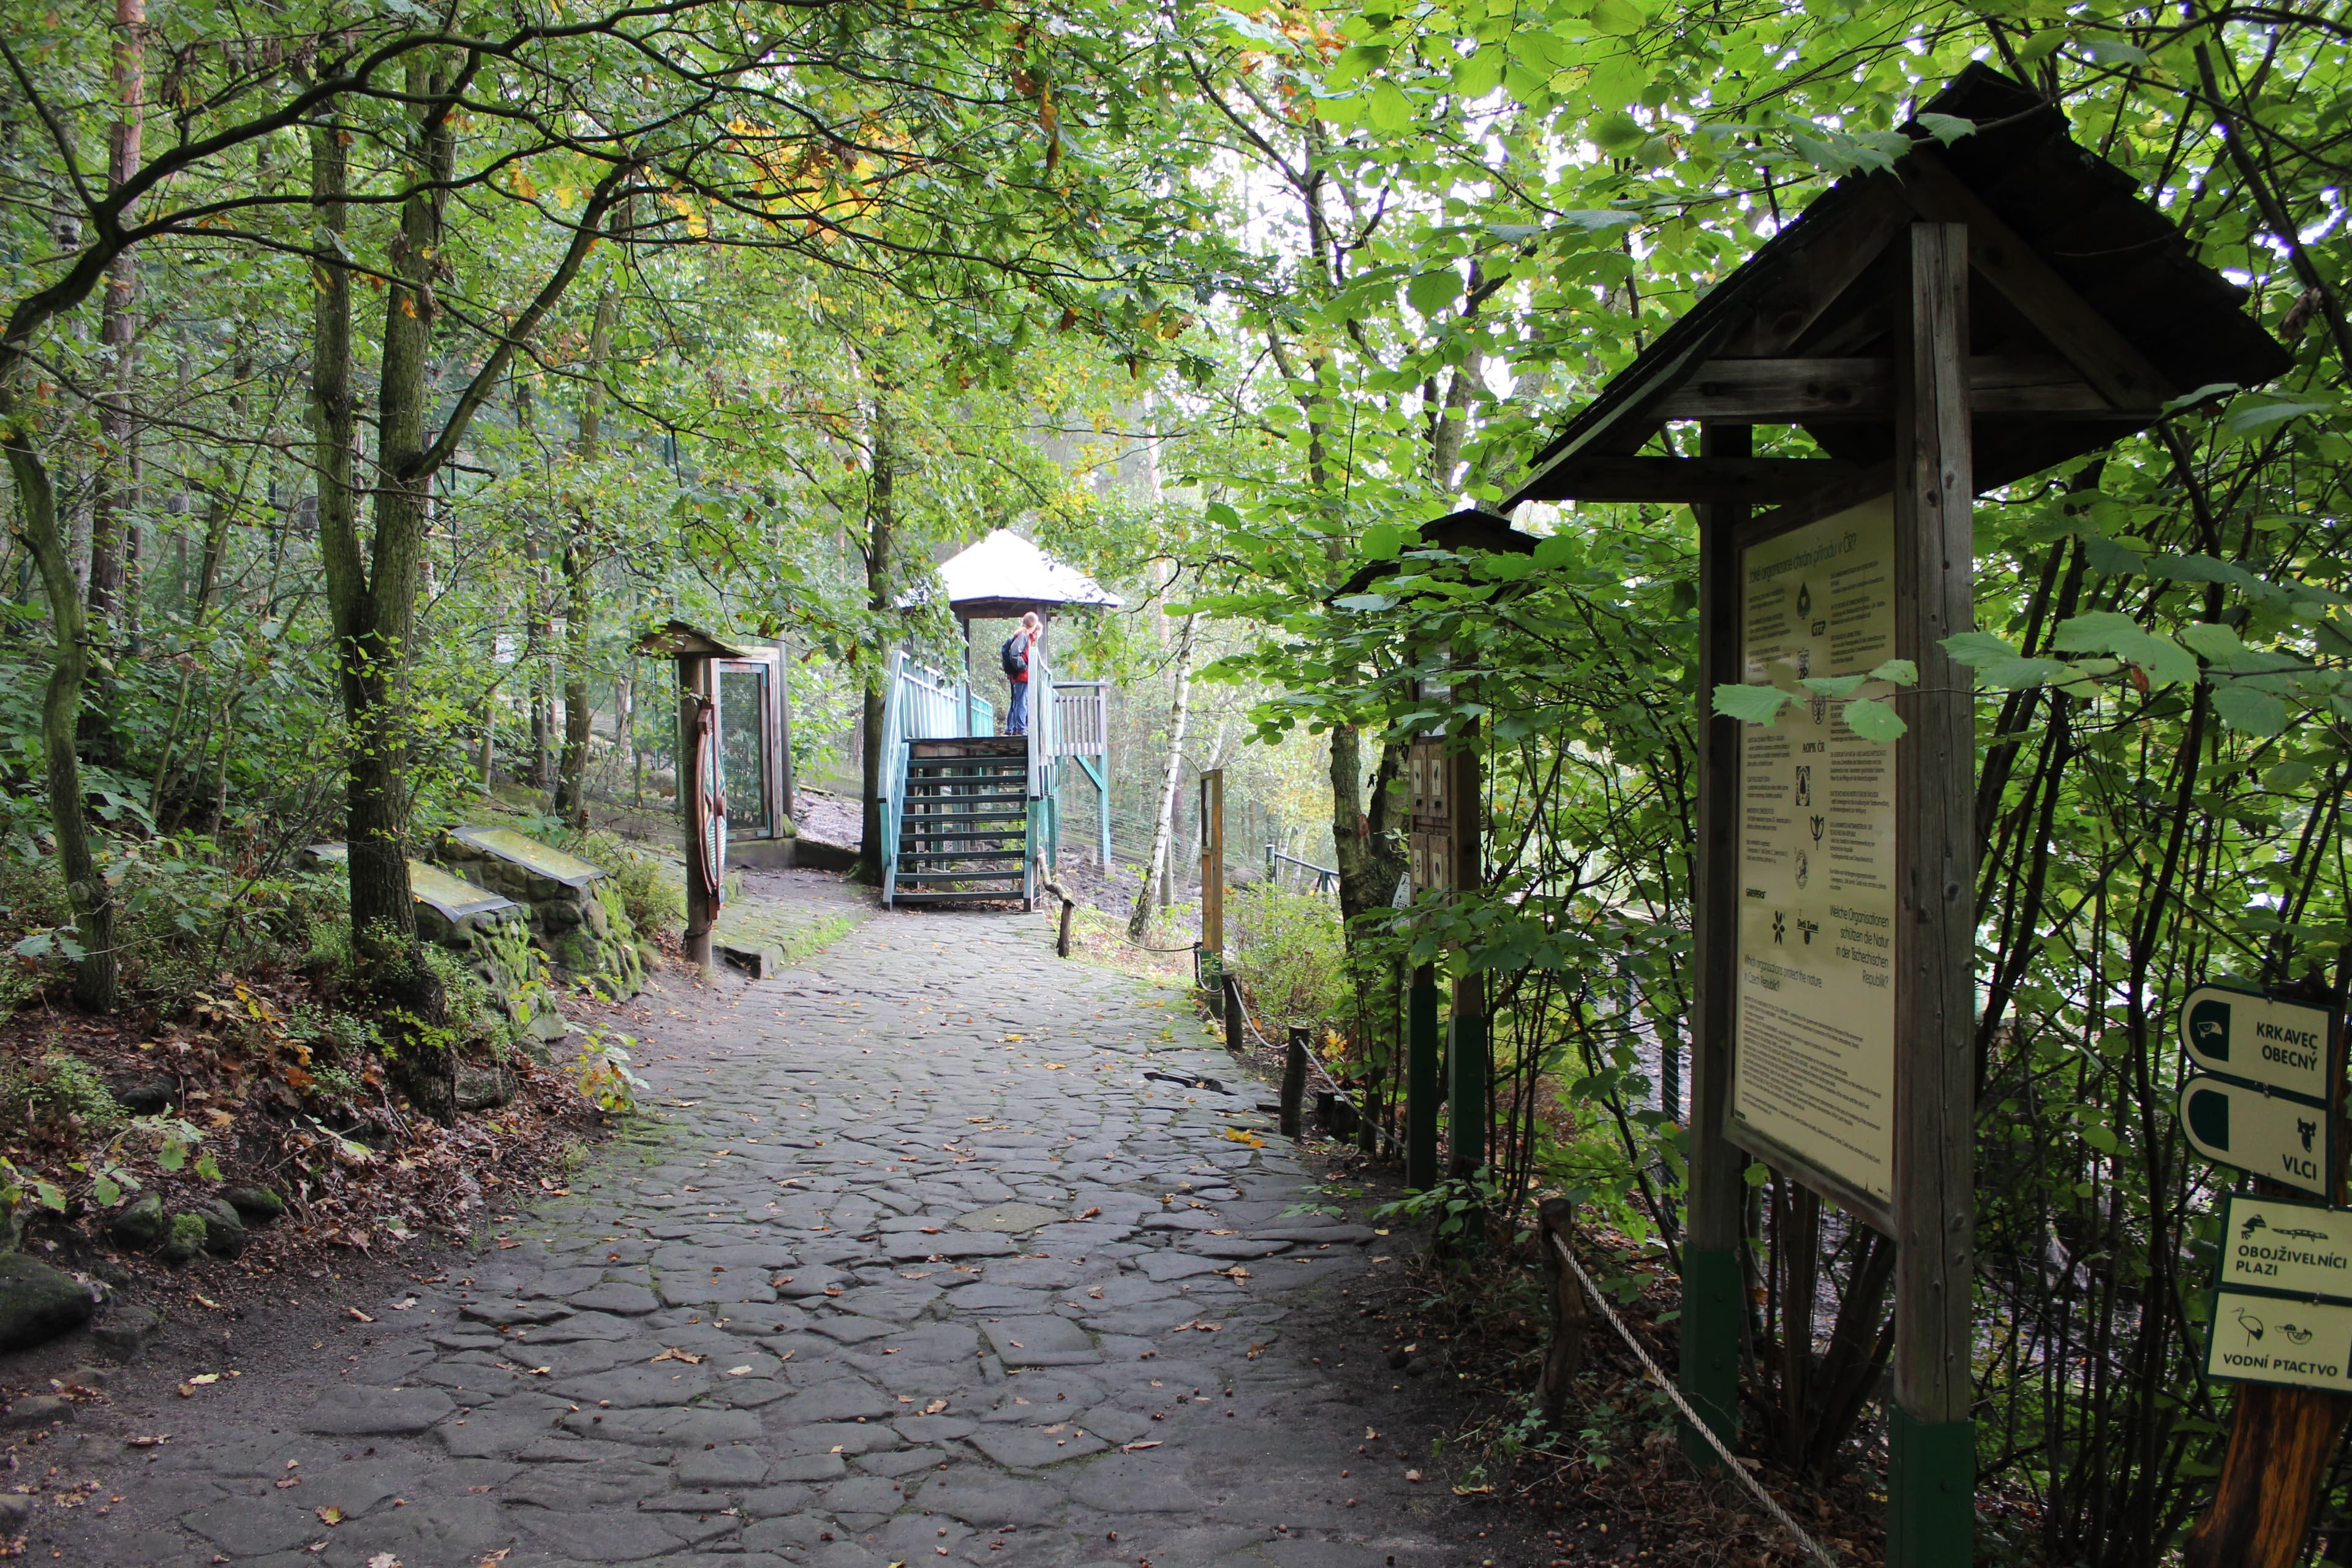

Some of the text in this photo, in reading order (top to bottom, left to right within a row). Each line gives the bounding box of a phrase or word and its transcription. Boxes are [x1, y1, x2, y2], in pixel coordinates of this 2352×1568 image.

[1844, 532, 1857, 553] ČR?
[1830, 904, 1889, 929] Welche Organisationen
[1840, 925, 1889, 949] schützen die Natur
[1836, 943, 1889, 968] in der Tschechischen
[1784, 967, 1799, 981] protect
[1807, 973, 1822, 989] nature
[1862, 969, 1889, 989] Republik?
[2256, 1022, 2318, 1050] KRKAVEC
[2262, 1045, 2317, 1071] OBECNÝ
[2282, 1153, 2316, 1181] VLCI
[2236, 1260, 2278, 1276] PLAZI
[2238, 1245, 2347, 1270] OBOJŽIVELNÍCI
[2223, 1353, 2338, 1377] VODNÍ PTACTVO
